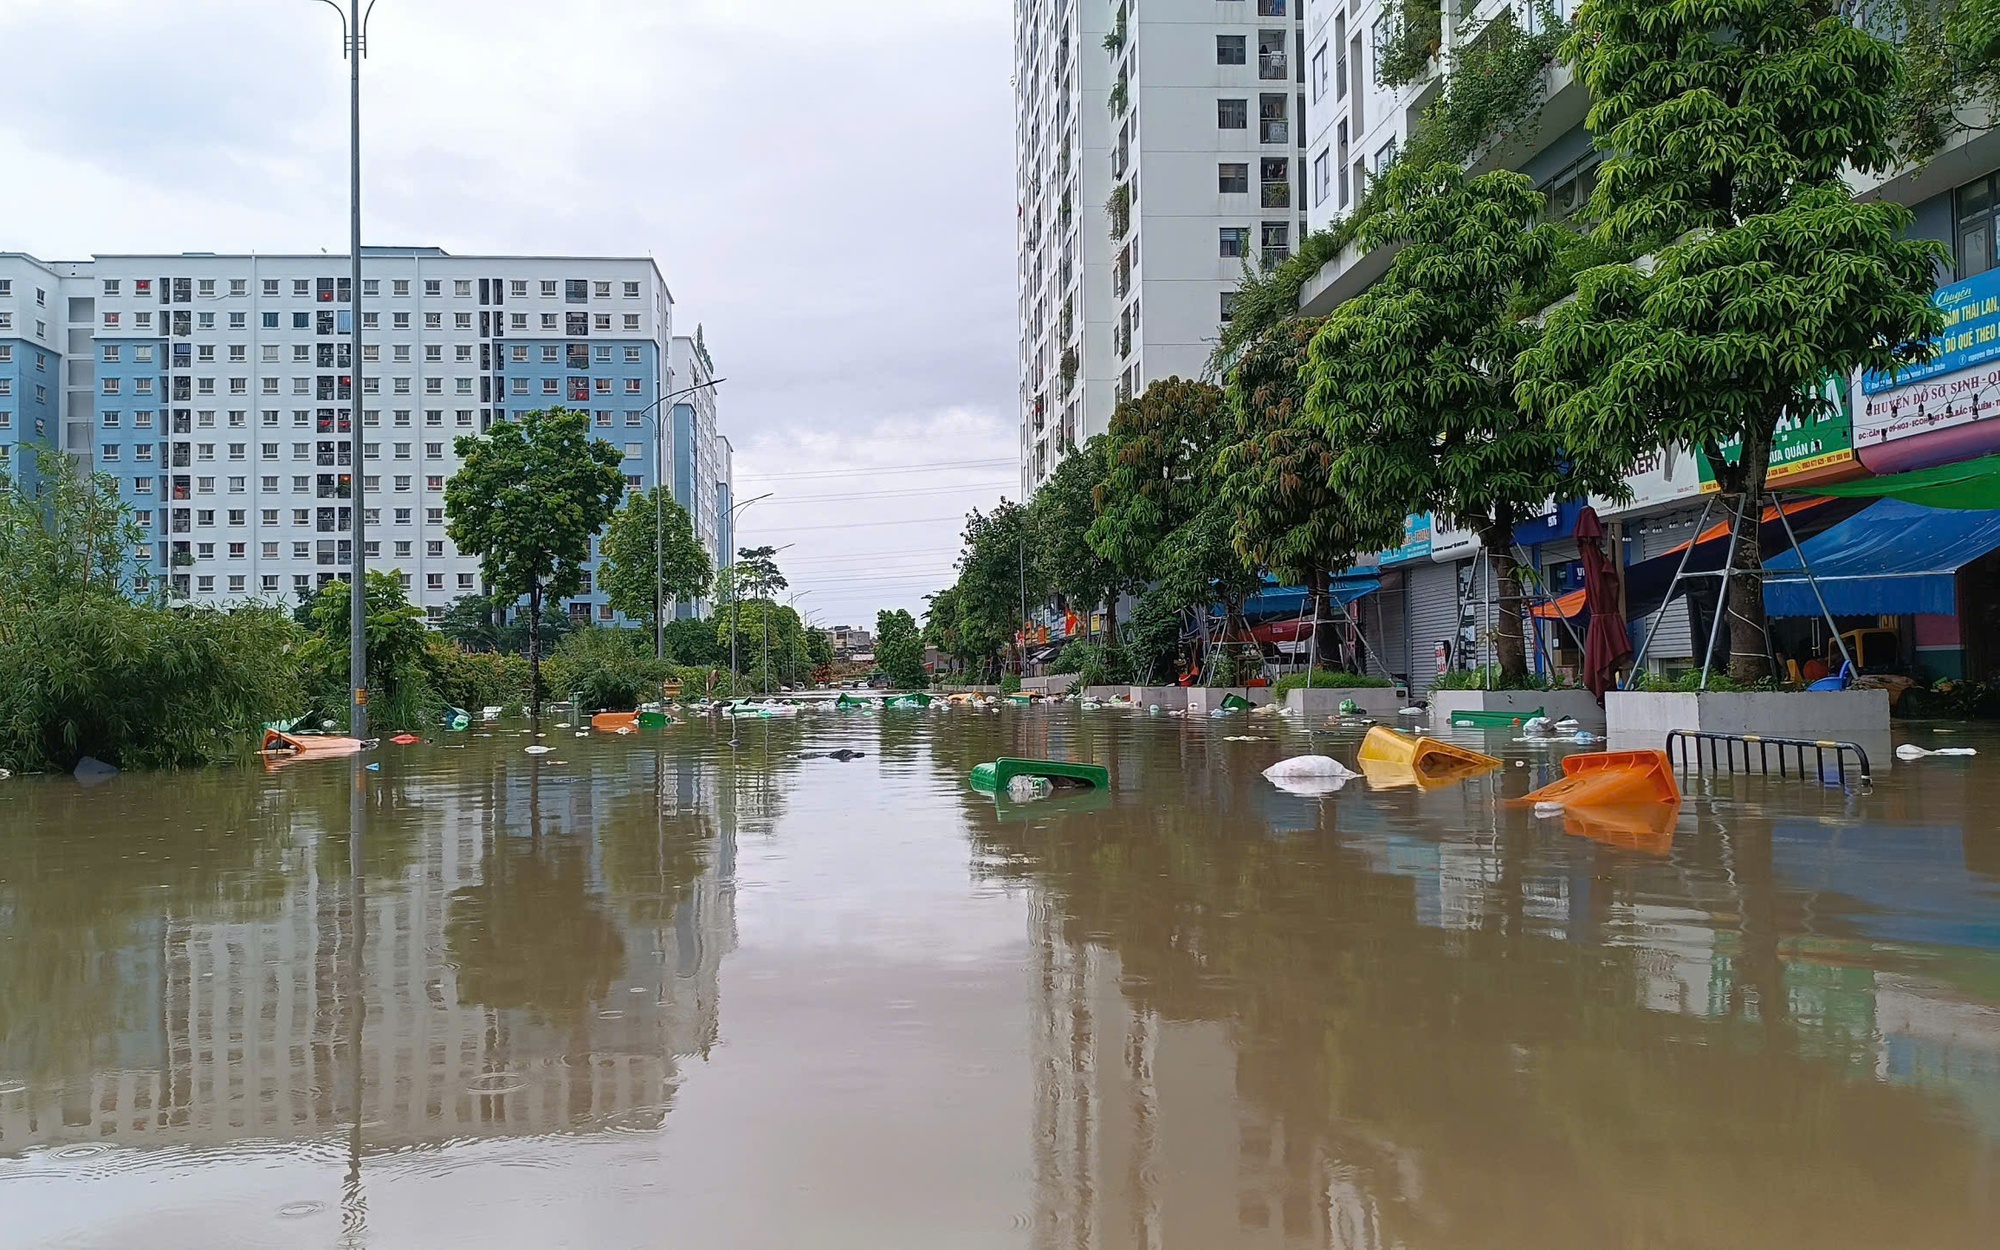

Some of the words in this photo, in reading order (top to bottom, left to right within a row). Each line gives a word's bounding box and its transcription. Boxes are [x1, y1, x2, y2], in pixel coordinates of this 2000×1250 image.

[1936, 287, 1972, 307] Chuyên
[1962, 301, 1979, 321] THÁI
[1975, 323, 1995, 344] THEO
[1950, 376, 1979, 395] SINH
[1622, 451, 1662, 478] AKERY
